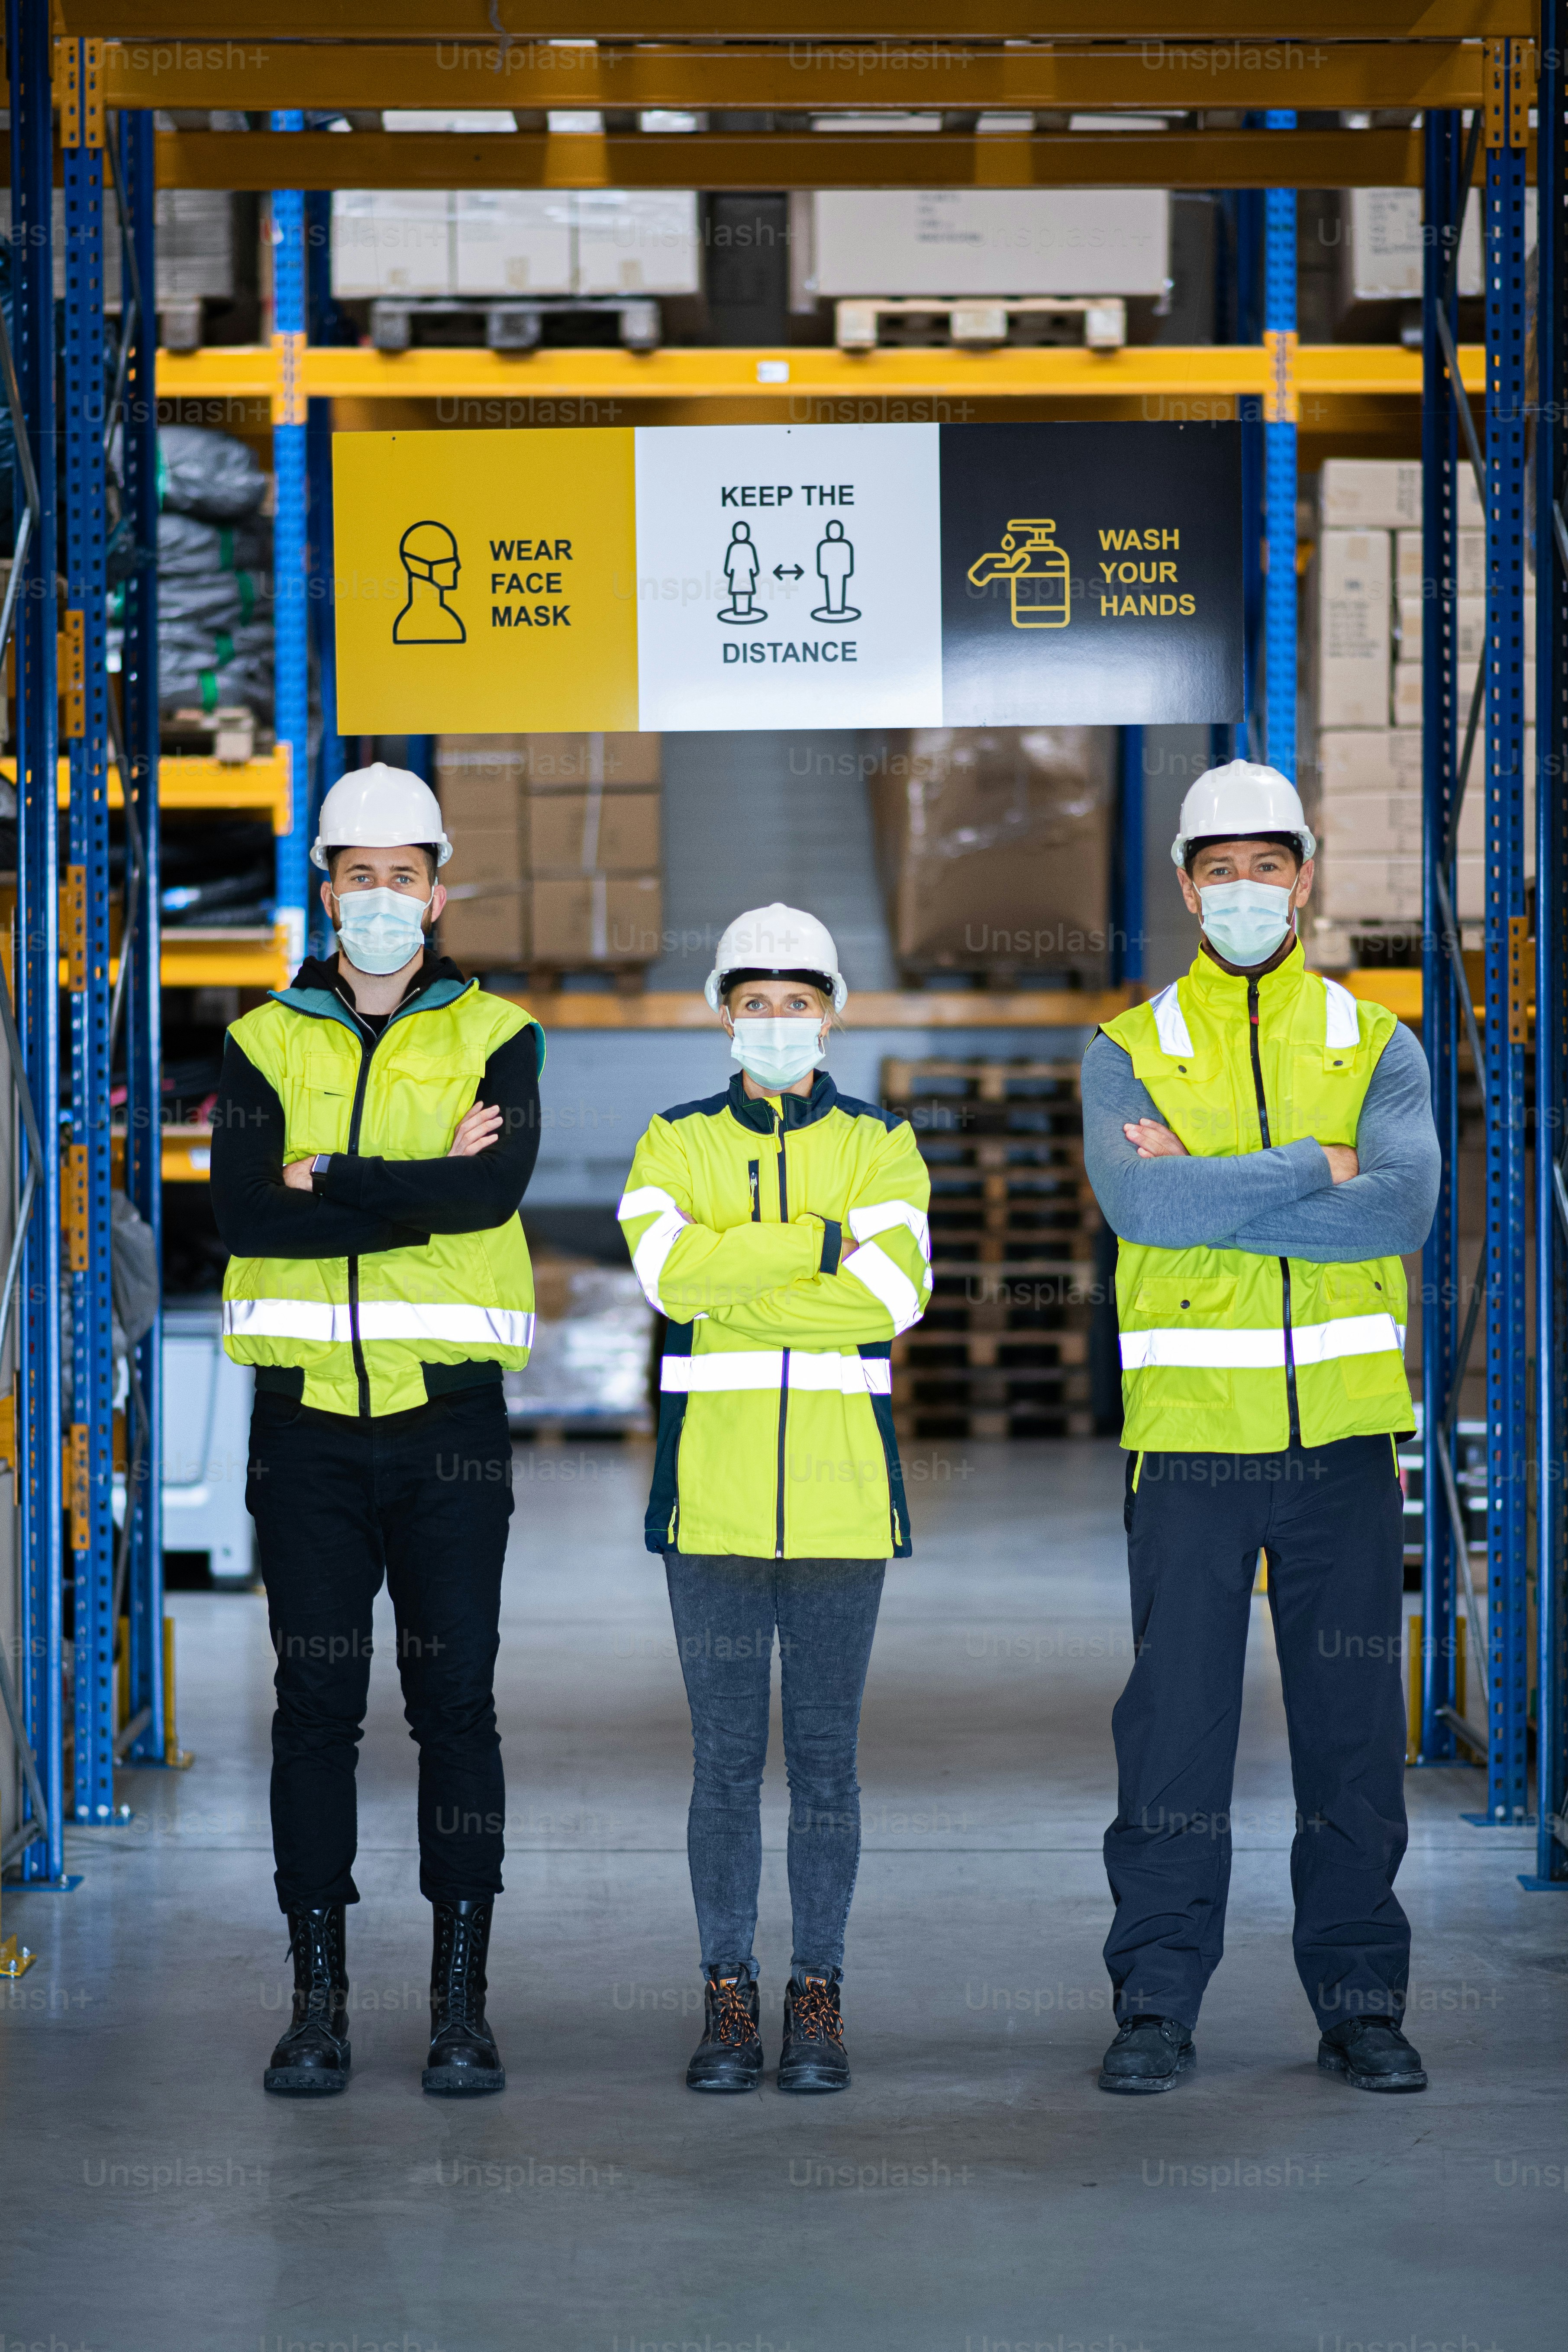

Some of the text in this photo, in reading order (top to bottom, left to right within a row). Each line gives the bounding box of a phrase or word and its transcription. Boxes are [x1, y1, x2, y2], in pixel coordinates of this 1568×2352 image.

[722, 485, 855, 507] KEEP THE
[489, 539, 573, 561] WEAR
[1099, 529, 1179, 550] WASH
[491, 572, 562, 594] FACE
[1100, 562, 1178, 583] YOUR
[492, 605, 571, 627] MASK
[1101, 594, 1196, 616] HANDS
[723, 642, 857, 663] DISTANCE
